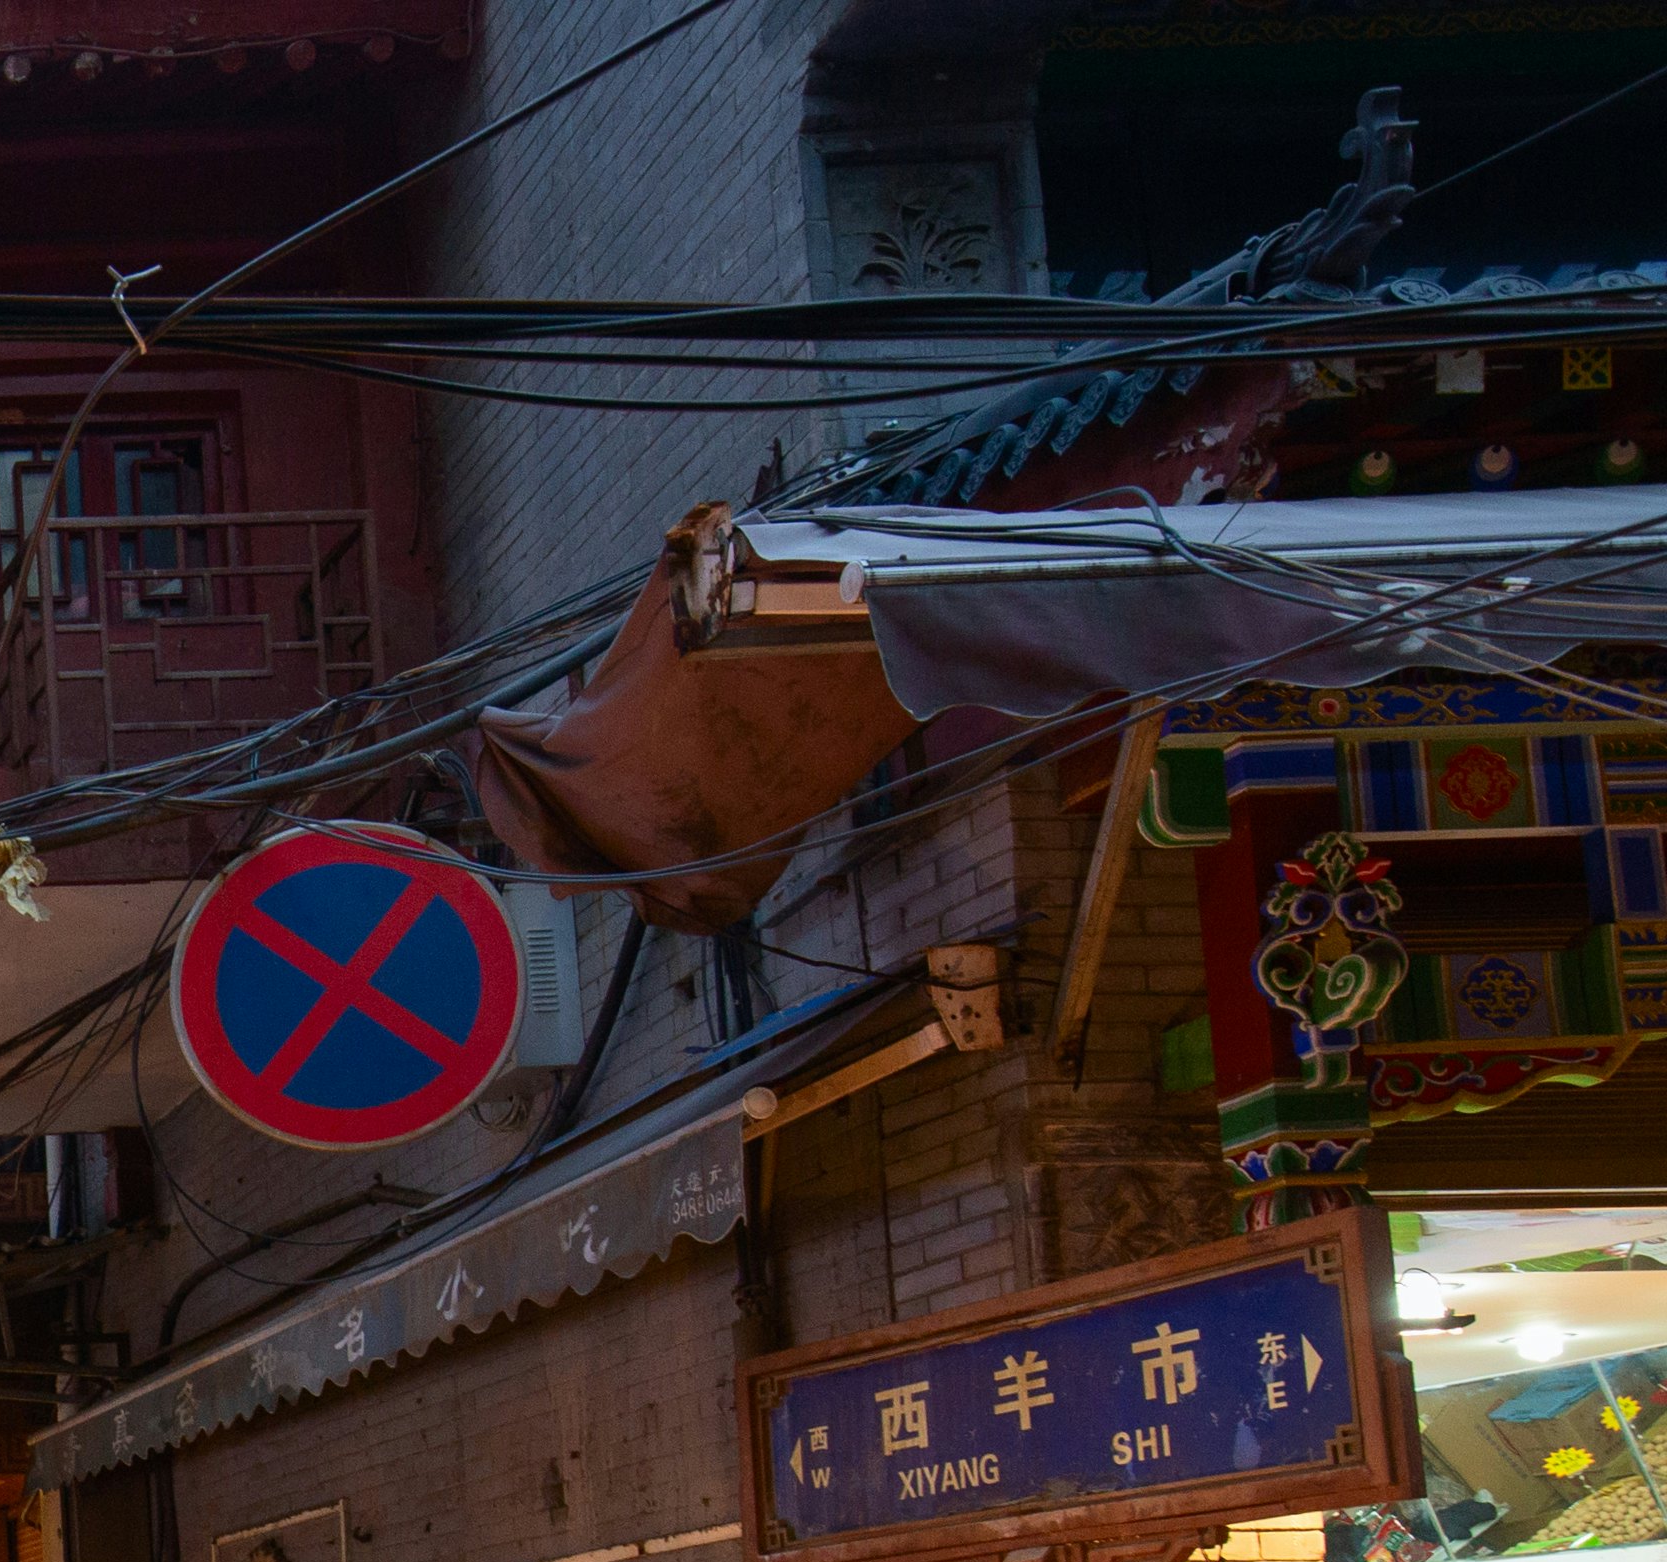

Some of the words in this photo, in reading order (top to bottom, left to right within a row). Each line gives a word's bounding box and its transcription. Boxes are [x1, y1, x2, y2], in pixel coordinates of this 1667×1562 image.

[1256, 1331, 1288, 1367] 东
[874, 1321, 1201, 1456] 西羊市
[1267, 1381, 1290, 1411] E
[808, 1425, 830, 1453] 西
[811, 1466, 832, 1490] W
[898, 1452, 1001, 1501] XIYANG
[1112, 1423, 1172, 1467] SHI
